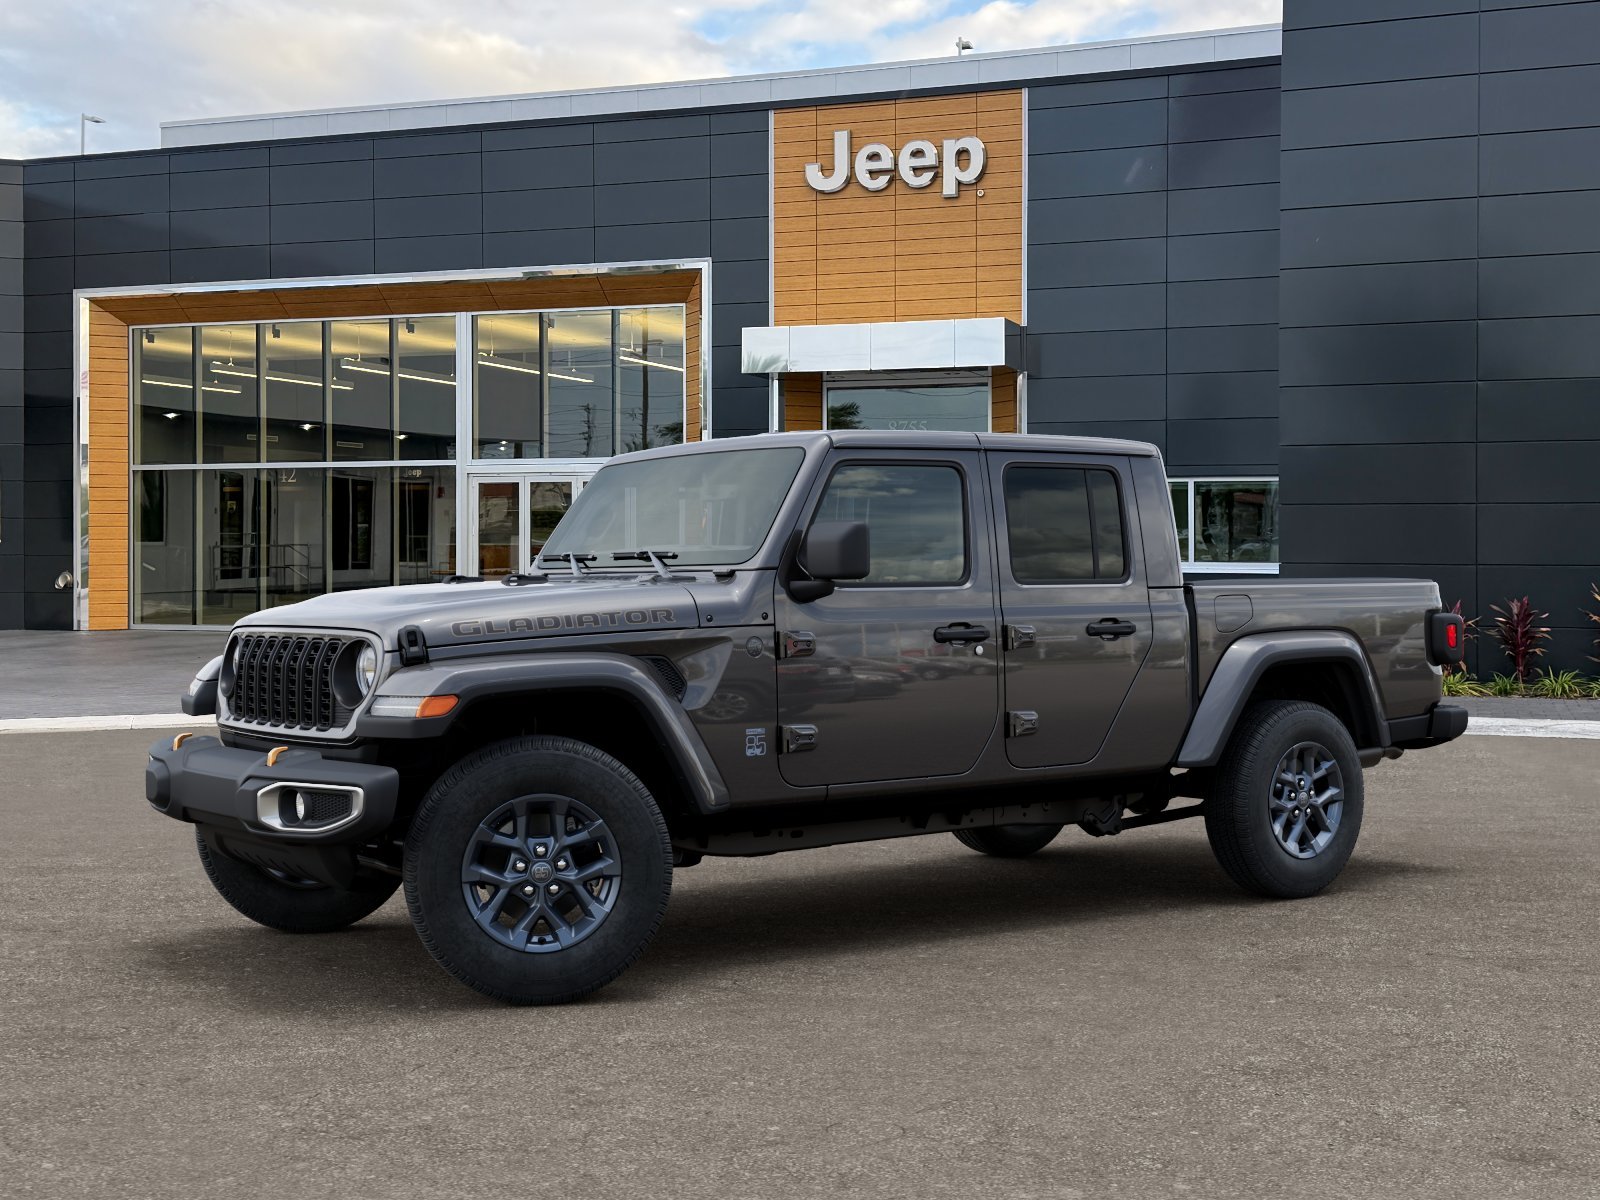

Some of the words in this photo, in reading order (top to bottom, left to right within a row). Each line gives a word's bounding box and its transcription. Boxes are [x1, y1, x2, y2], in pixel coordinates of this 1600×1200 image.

[805, 129, 987, 198] Jeep
[451, 608, 677, 637] GLADIATOR
[746, 735, 766, 756] 85
